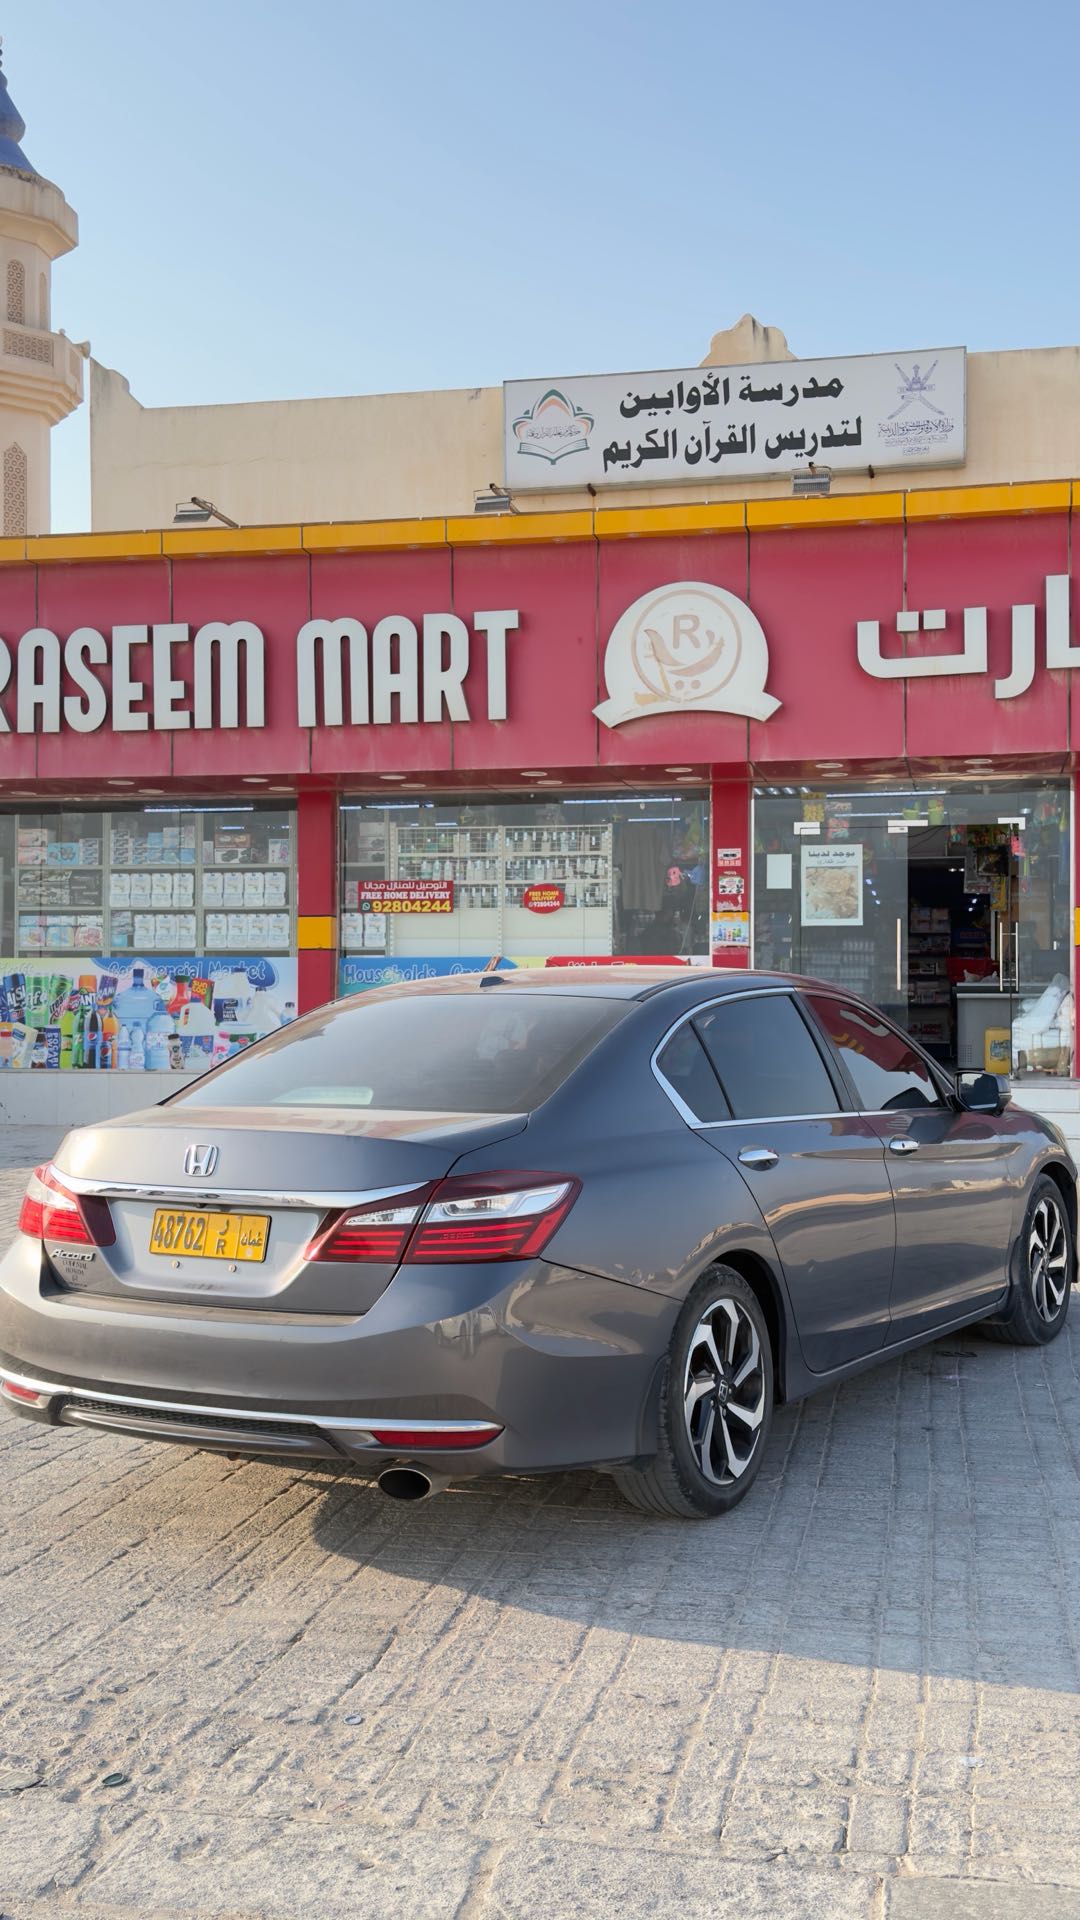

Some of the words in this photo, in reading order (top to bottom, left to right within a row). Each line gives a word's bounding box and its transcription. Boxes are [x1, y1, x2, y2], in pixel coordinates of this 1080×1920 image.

[619, 372, 730, 418] الأوابين
[738, 375, 845, 407] مدرسة
[602, 428, 678, 472] الكريم
[684, 420, 756, 465] القرآن
[764, 416, 862, 459] لتدريس
[857, 574, 1080, 700] ارت
[0, 620, 266, 734] ASEEM
[297, 609, 520, 729] MART
[361, 891, 382, 900] FREE
[384, 891, 408, 900] HOME
[409, 891, 451, 900] DELIVERY
[386, 881, 415, 891] للمنازل
[415, 881, 448, 891] التوصيل
[372, 900, 452, 912] 92804244
[154, 1214, 206, 1251] 48762
[215, 1238, 226, 1255] R
[50, 1249, 96, 1262] Accord
